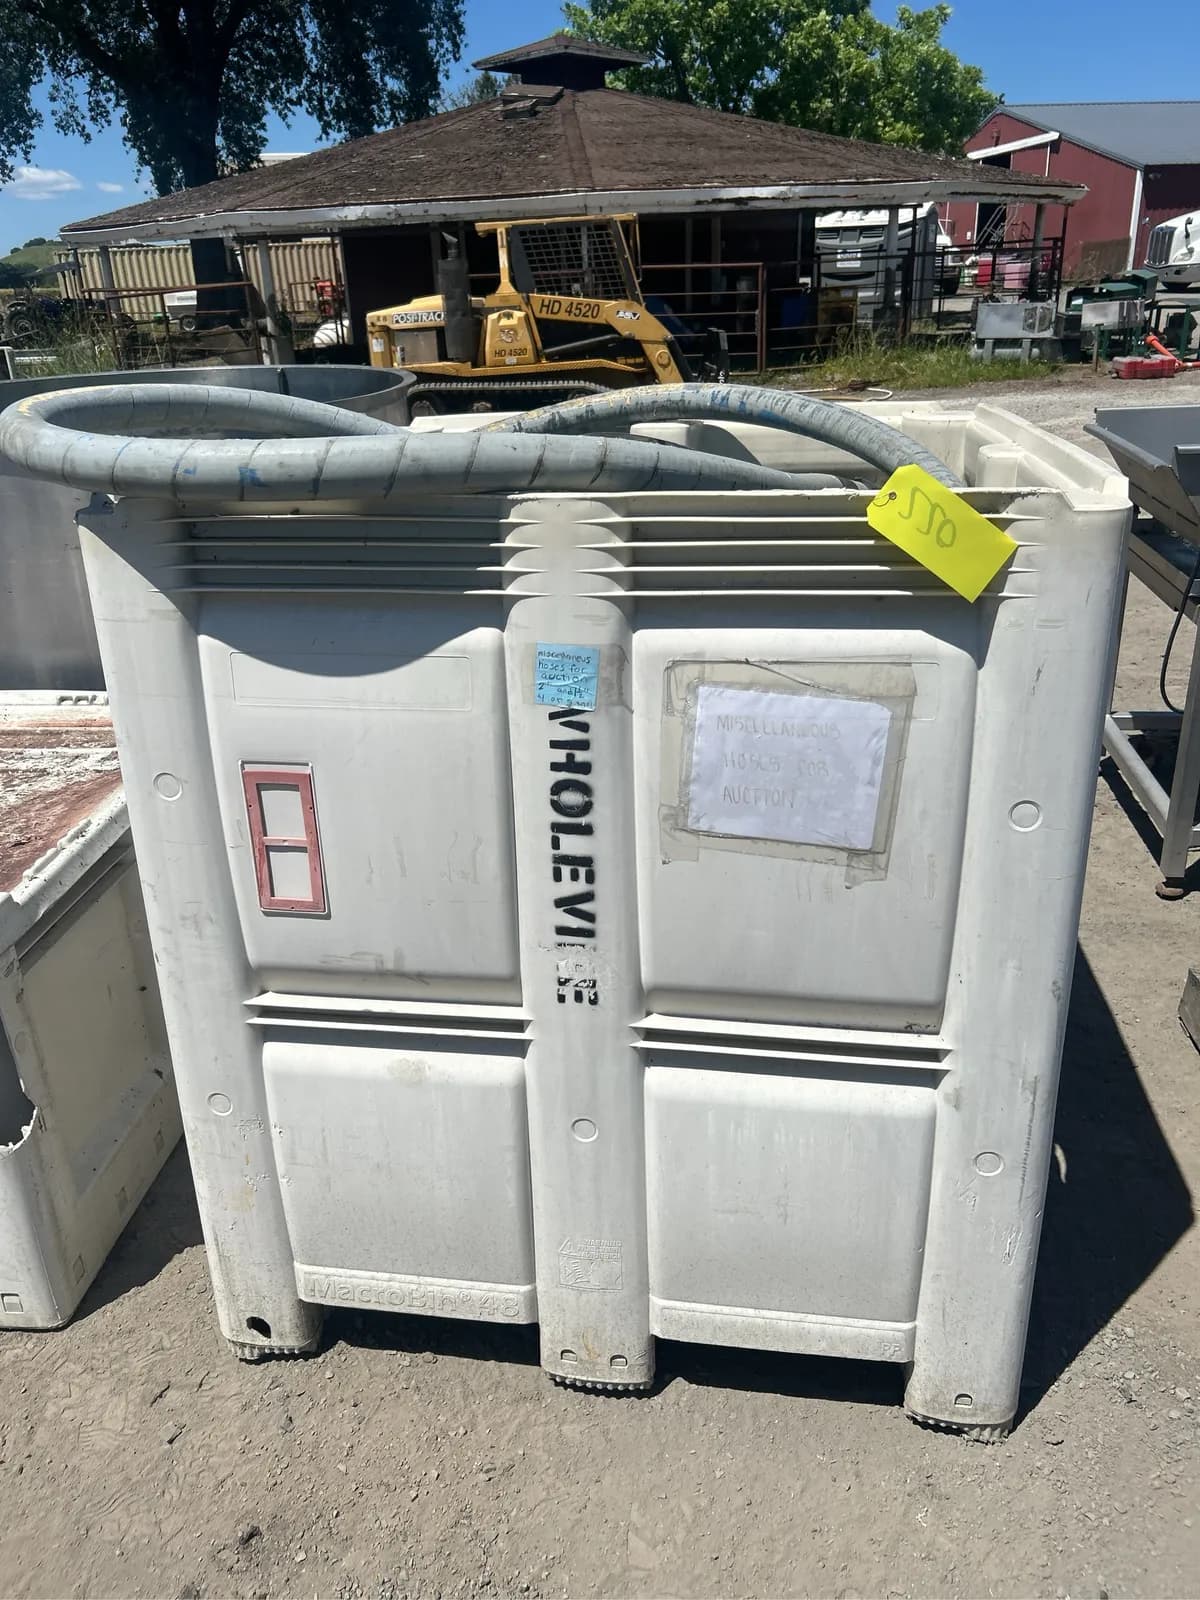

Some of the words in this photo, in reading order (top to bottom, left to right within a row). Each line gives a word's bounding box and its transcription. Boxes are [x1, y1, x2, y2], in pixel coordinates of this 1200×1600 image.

[538, 299, 562, 316] HD
[564, 302, 600, 319] 4520
[494, 349, 506, 358] HD
[508, 347, 528, 357] 4520
[538, 659, 565, 672] hoses
[722, 751, 780, 773] HOSES
[722, 784, 796, 808] AUCTION
[479, 1292, 521, 1318] 48
